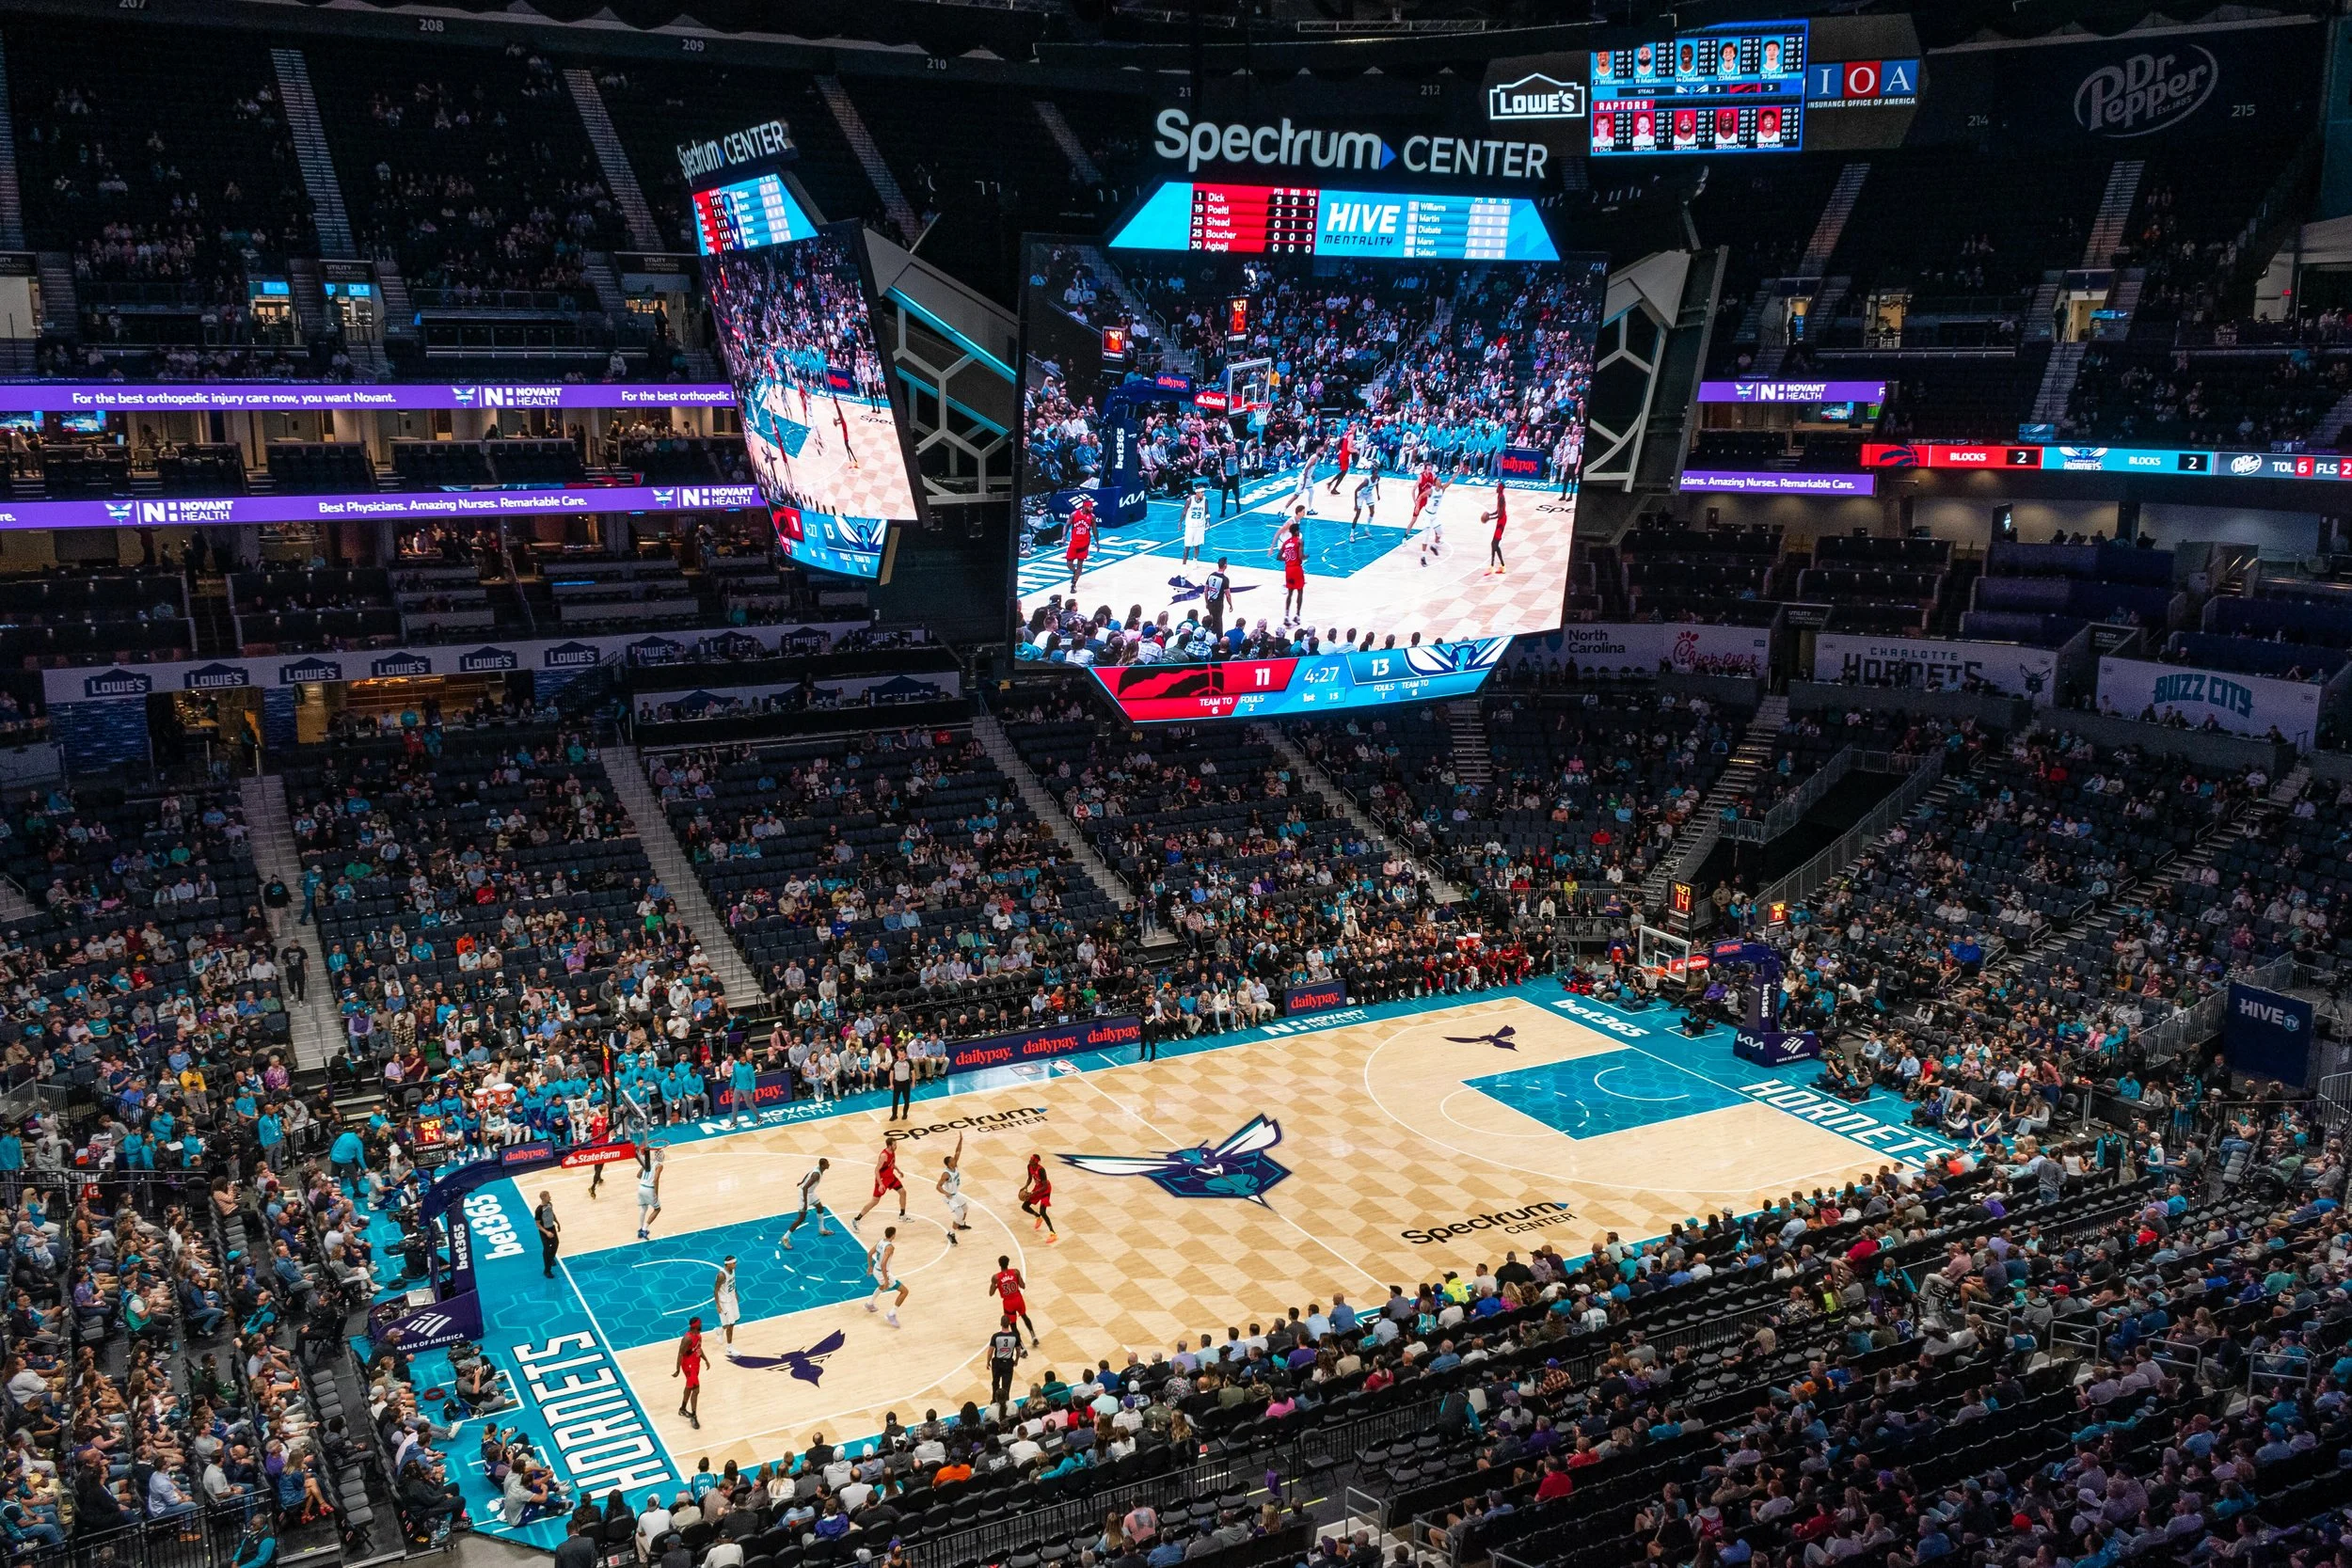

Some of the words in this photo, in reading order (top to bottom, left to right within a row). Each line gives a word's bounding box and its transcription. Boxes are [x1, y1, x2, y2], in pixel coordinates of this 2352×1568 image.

[419, 18, 445, 32] 208
[682, 39, 706, 52] 209
[926, 57, 947, 71] 210
[2125, 54, 2176, 93] Dr
[1500, 89, 1575, 113] LOWE'S
[1807, 100, 1845, 109] INSURANCE
[1848, 98, 1871, 106] OFFICE
[1873, 98, 1883, 106] OF
[1884, 97, 1915, 105] AMERICA
[2074, 65, 2207, 131] Pepper
[1599, 101, 1648, 110] RAPTORS
[2232, 105, 2256, 118] 215
[1154, 108, 1381, 172] Spectrum
[1403, 135, 1549, 179] CENTER
[677, 139, 723, 187] Spectrum
[723, 120, 788, 165] CENTER
[1208, 193, 1225, 202] Dick
[1276, 196, 1282, 205] 5
[1292, 197, 1298, 205] 0
[1309, 198, 1315, 206] 0
[1194, 204, 1203, 213] 19
[1275, 208, 1281, 217] 2
[1291, 209, 1296, 217] 3
[1421, 202, 1446, 212] Williams
[1193, 217, 1203, 226] 23
[1207, 217, 1231, 227] Shead
[1275, 220, 1280, 229] 0
[1292, 221, 1295, 230] 1
[1307, 221, 1313, 230] 0
[1327, 202, 1401, 234] HIVE
[1419, 214, 1439, 223] Martin
[1192, 229, 1202, 237] 25
[1206, 230, 1237, 240] Boucher
[1274, 232, 1279, 241] 0
[1289, 233, 1295, 242] 0
[1306, 233, 1311, 242] 0
[1418, 225, 1441, 234] Diabate
[1324, 234, 1393, 245] MENTALITY
[1417, 237, 1435, 245] Mann
[1191, 241, 1202, 249] 30
[1205, 242, 1229, 252] Agbaji
[1288, 245, 1294, 253] 0
[1305, 245, 1311, 253] 0
[516, 388, 562, 397] NOVANT
[1787, 384, 1826, 392] NOVANT
[72, 392, 92, 404] For
[95, 392, 115, 404] the
[119, 392, 144, 404] best
[147, 392, 209, 406] orthopedic
[211, 393, 244, 406] injury
[246, 395, 270, 404] care
[272, 394, 299, 404] now,
[302, 394, 322, 405] you
[325, 392, 352, 404] want
[355, 391, 396, 404] Novant.
[516, 396, 558, 405] HEALTH
[622, 391, 637, 401] For
[640, 391, 656, 401] the
[658, 390, 678, 402] best
[680, 390, 729, 403] orthopedic
[1787, 391, 1822, 400] HEALTH
[1114, 427, 1124, 469] bet365
[1949, 451, 1986, 462] BLOCKS
[2016, 451, 2027, 464] 2
[2128, 455, 2161, 466] BLOCKS
[2188, 457, 2197, 469] 2
[2272, 461, 2295, 472] TOL
[2297, 462, 2307, 473] 6
[2316, 463, 2338, 474] FLS
[2343, 463, 2352, 475] 2
[1708, 477, 1744, 488] Amazing
[1746, 478, 1778, 487] Nurses.
[1780, 479, 1831, 488] Remarkable
[1832, 480, 1854, 489] Care.
[711, 487, 754, 496] NOVANT
[180, 500, 233, 512] NOVANT
[319, 502, 344, 513] Best
[347, 500, 406, 514] Physicians.
[409, 499, 456, 512] Amazing
[458, 499, 498, 510] Nurses.
[501, 497, 560, 509] Remarkable
[562, 497, 587, 507] Care.
[712, 496, 751, 506] HEALTH
[181, 511, 230, 521] HEALTH
[1568, 628, 1608, 642] North
[1568, 641, 1626, 655] Carolina
[1870, 647, 1959, 661] CHARLOTTE
[466, 655, 512, 670] LOWE'S
[549, 649, 596, 664] LOWE'S
[286, 667, 335, 682] LOWE'S
[377, 660, 426, 675] LOWE'S
[1254, 668, 1270, 687] 11
[1304, 666, 1340, 684] 4:27
[1372, 658, 1390, 676] 13
[91, 677, 146, 693] LOWE'S
[191, 672, 244, 687] LOWE'S
[1374, 683, 1394, 692] FOULS
[1401, 681, 1419, 689] TEAM
[1420, 679, 1429, 688] TO
[1303, 692, 1315, 703] 1st
[1328, 692, 1339, 701] 15
[1411, 688, 1418, 696] 6
[2153, 673, 2206, 705] BUZZ
[2208, 675, 2254, 719] CITY
[1200, 698, 1220, 706] TEAM
[1222, 697, 1232, 705] TO
[1240, 694, 1264, 704] FOULS
[1212, 706, 1218, 715] 6
[1248, 704, 1255, 712] 2
[1675, 883, 1691, 896] 4:27
[1677, 895, 1689, 911] 14
[1290, 991, 1340, 1009] dailypay.
[1760, 984, 1771, 1018] bet365
[1302, 1009, 1365, 1024] NOVANT
[1550, 999, 1650, 1038] bet365
[2239, 997, 2284, 1025] HIVE
[2286, 1019, 2298, 1028] TV
[1309, 1013, 1370, 1028] HEALTH
[955, 1046, 1013, 1069] dailypay.
[1023, 1035, 1078, 1056] dailypay.
[1088, 1024, 1140, 1046] dailypay.
[761, 1107, 834, 1123] HEALTH
[882, 1106, 1040, 1141] Spectrum
[977, 1116, 1048, 1133] CENTER
[1739, 1078, 1958, 1169] HORNETS
[424, 1131, 437, 1141] 14
[505, 1147, 549, 1162] dailypay.
[465, 1194, 526, 1260] bet365
[1401, 1201, 1564, 1244] Spectrum
[1503, 1212, 1578, 1234] CENTER
[456, 1223, 466, 1270] bet365
[1002, 1281, 1017, 1295] 30
[430, 1333, 464, 1345] AMERICA
[1003, 1338, 1009, 1347] 3
[512, 1329, 671, 1501] HORNETS
